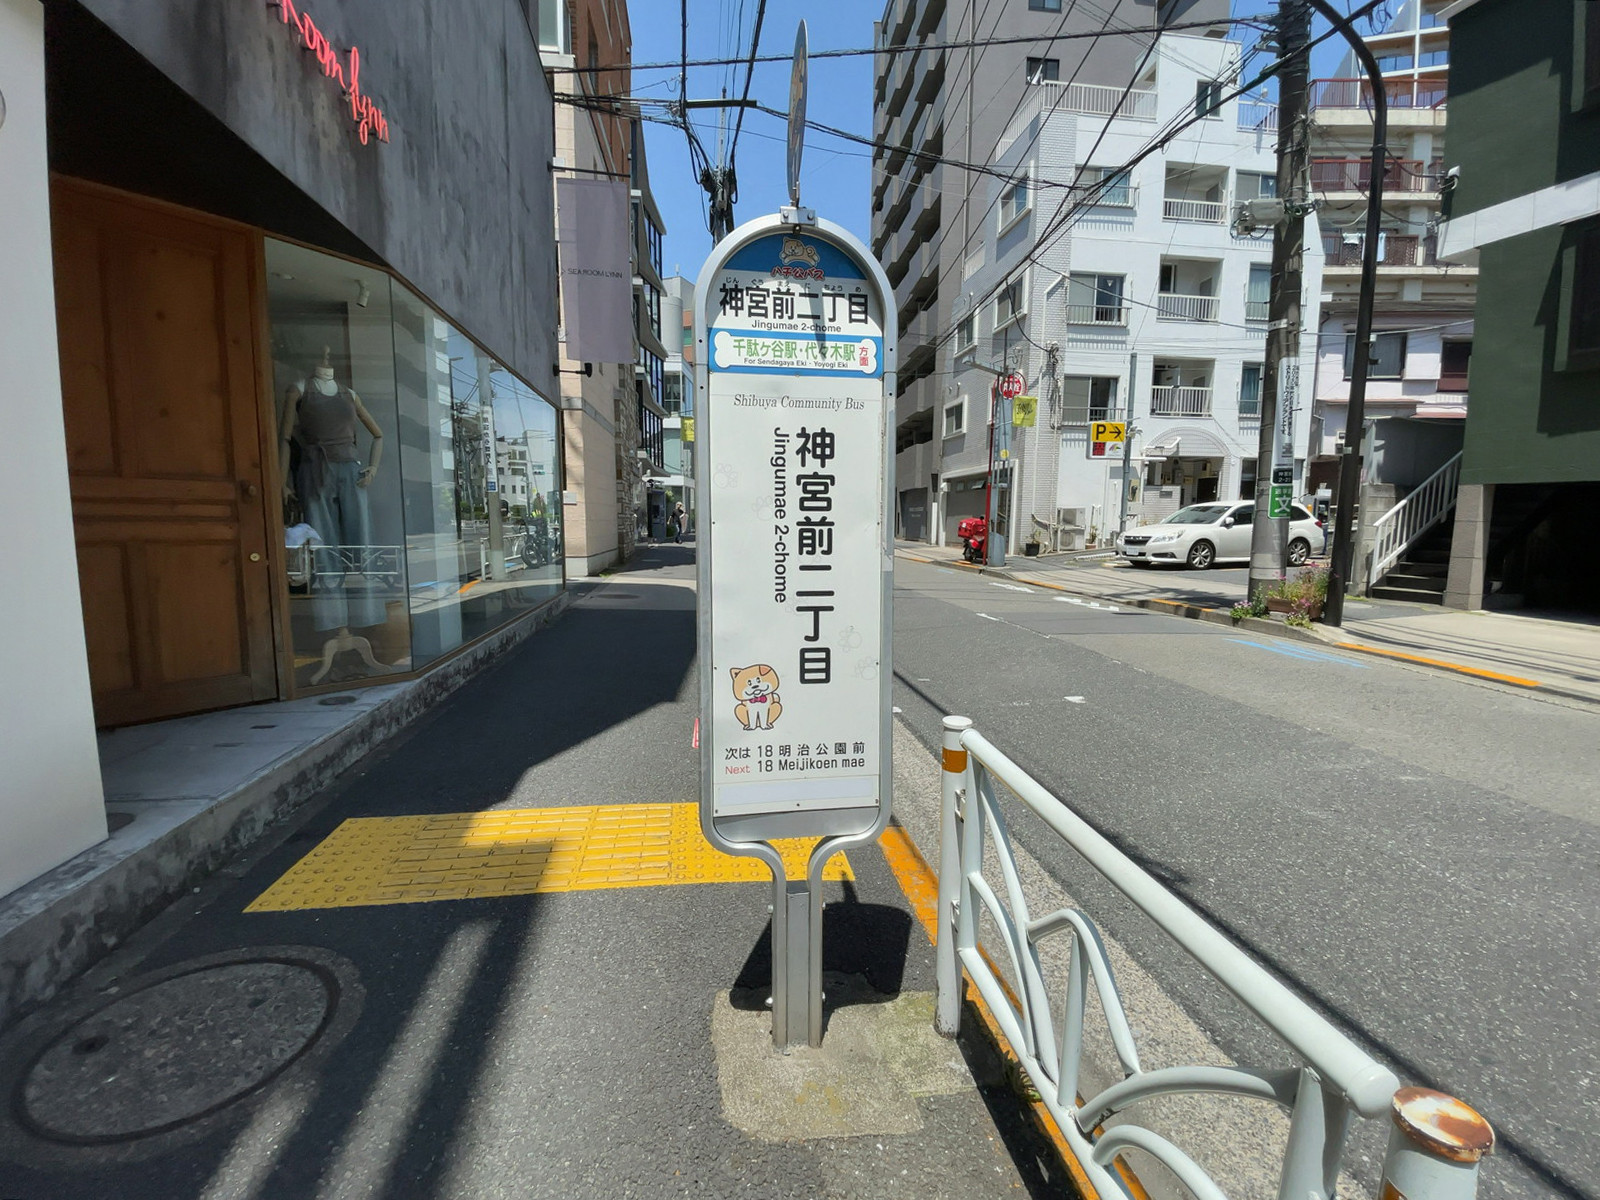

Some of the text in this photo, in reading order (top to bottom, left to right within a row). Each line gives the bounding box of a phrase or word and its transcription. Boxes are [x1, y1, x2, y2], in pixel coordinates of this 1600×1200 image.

[582, 269, 605, 278] ROOM
[771, 266, 825, 281] ハチ公バス
[720, 284, 868, 324] 神宮前二丁目
[752, 320, 842, 332] Jingumae 2-chome
[757, 358, 794, 367] Sendagaya
[734, 394, 865, 411] Shibuya Community Bus
[1096, 424, 1106, 440] P
[770, 427, 790, 604] Jingumae 2-chome
[795, 426, 836, 685] 神宮前二丁目
[725, 742, 865, 760] 次は 18 明治公園前
[725, 758, 865, 775] Next 18 Meijikoen mae
